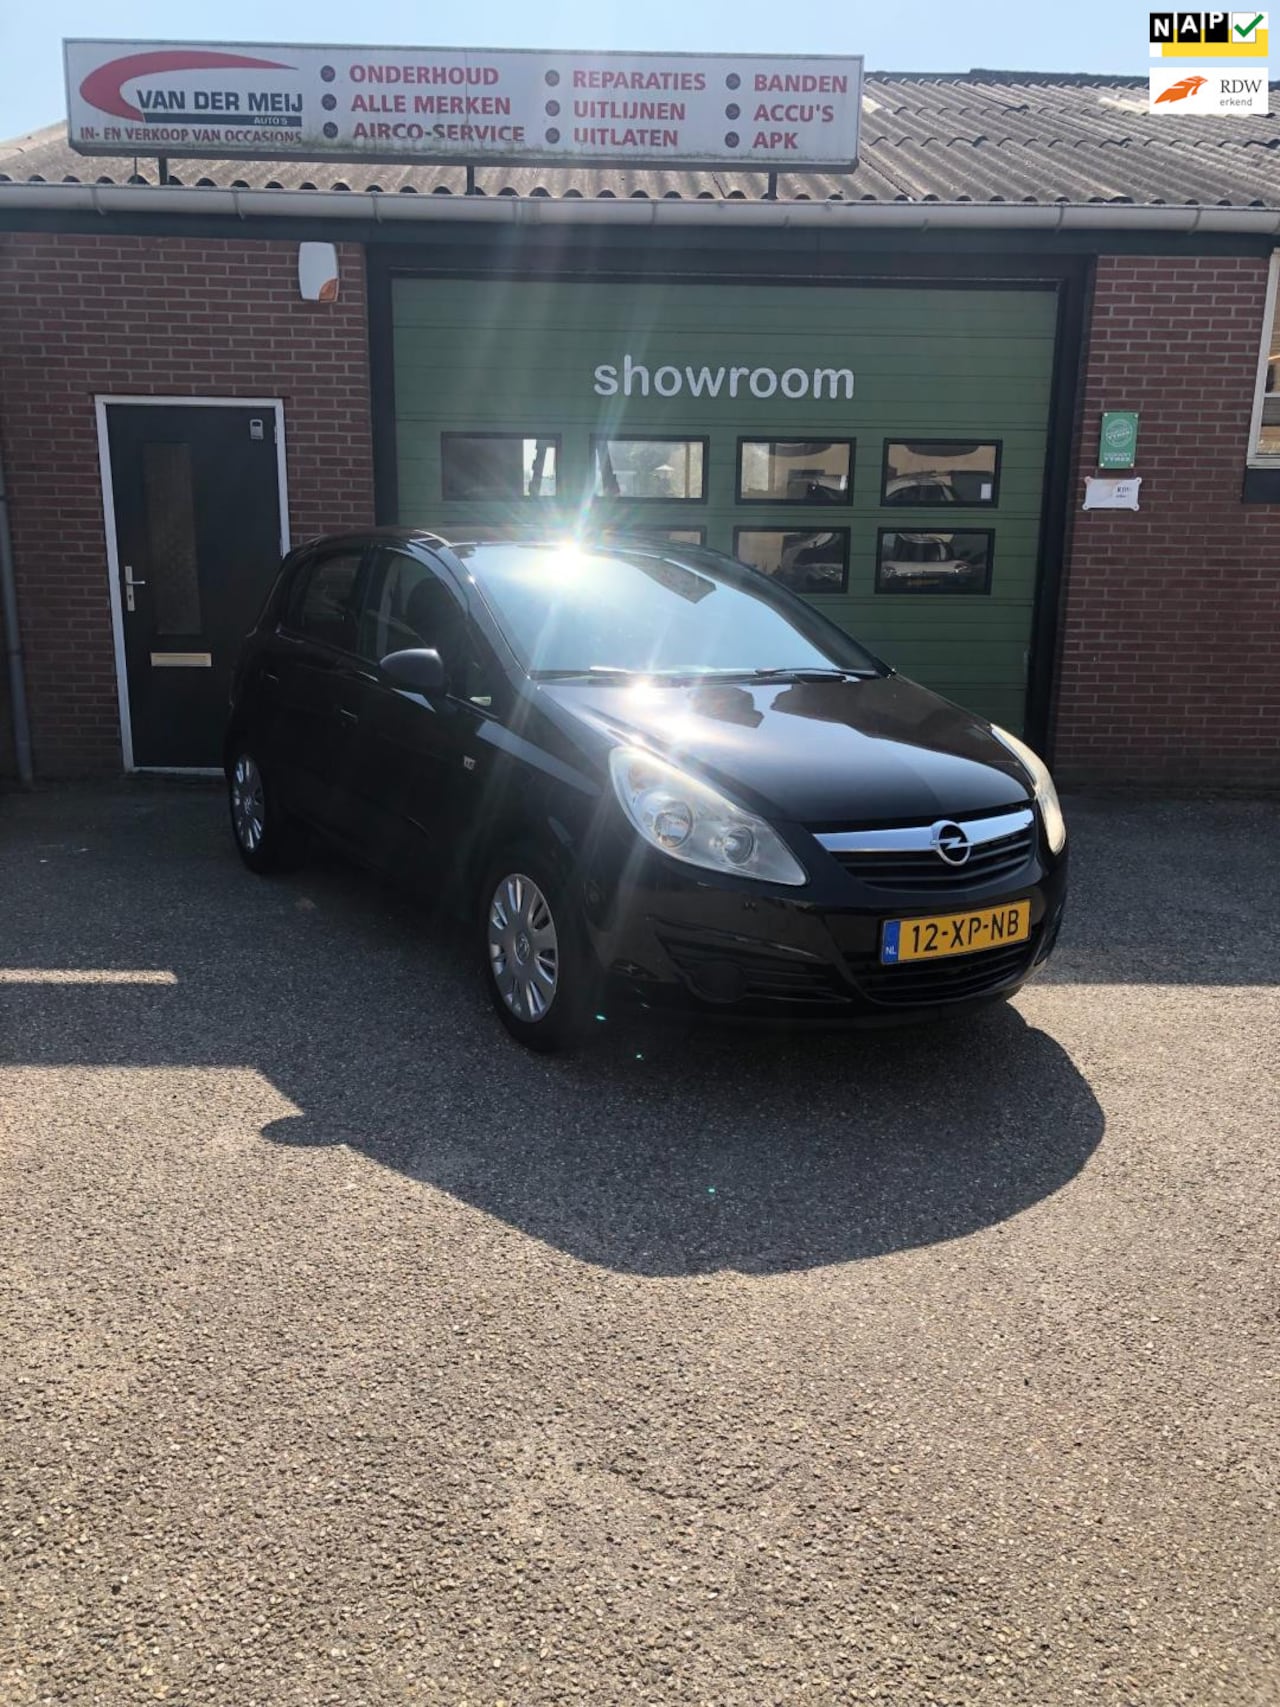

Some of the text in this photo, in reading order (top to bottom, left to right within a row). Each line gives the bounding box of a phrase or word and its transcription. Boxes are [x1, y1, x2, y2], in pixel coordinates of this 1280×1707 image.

[349, 65, 499, 85] ONDERHOUD
[572, 70, 706, 91] REPARATIES
[753, 74, 848, 94] BANDEN
[136, 90, 303, 112] VAN DER MEIJ
[351, 94, 511, 115] ALLE MERKEN
[573, 101, 686, 121] UITLIJNEN
[752, 104, 835, 123] ACCU'S
[80, 127, 302, 143] IN- EN VERKOOP VAN OCCASIONS
[353, 122, 525, 142] AIRCO-SERVICE
[573, 128, 679, 147] UITLATEN
[751, 131, 799, 150] APK
[593, 354, 855, 399] showroom
[912, 909, 1020, 953] 12-XP-NB
[885, 945, 897, 955] NL
